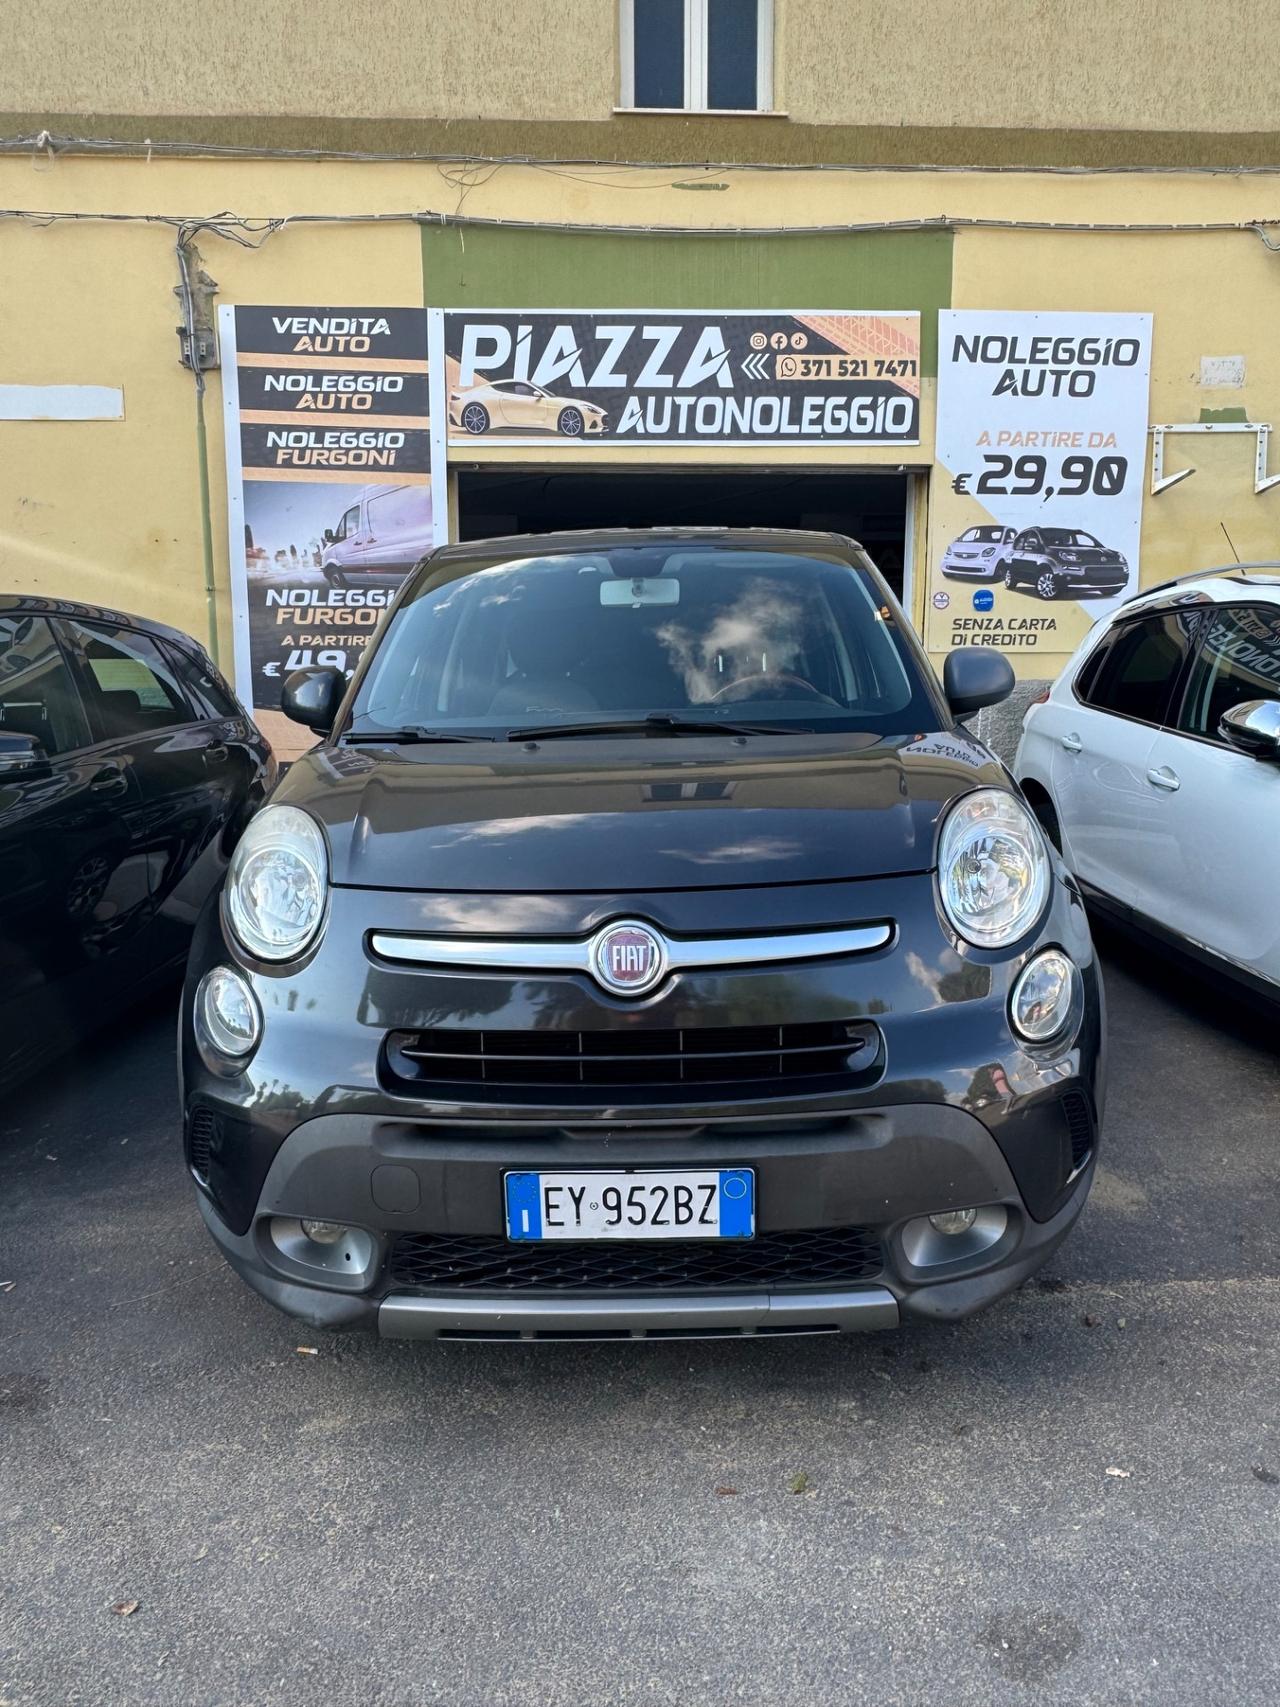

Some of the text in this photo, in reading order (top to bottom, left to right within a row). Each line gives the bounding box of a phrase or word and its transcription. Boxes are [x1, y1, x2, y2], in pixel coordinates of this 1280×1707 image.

[272, 317, 391, 335] VENDITA
[293, 336, 371, 352] AUTO
[952, 335, 1141, 366] NOLEGGIO
[459, 324, 734, 388] PIAZZA
[800, 359, 917, 377] 371 521 7471
[264, 374, 404, 393] NOLEGGIO
[991, 368, 1096, 397] AUTO
[296, 393, 373, 410] AUTO
[616, 395, 914, 434] AUTONOLEGGIO
[266, 431, 405, 448] NOLEGGIO
[976, 430, 1117, 448] A PARTIRE DA
[276, 449, 396, 466] FURGONI
[951, 454, 1128, 502] € 29,90
[266, 589, 396, 606] NOLEGGI
[276, 608, 387, 625] FURGO
[952, 618, 1057, 631] SENZA CARTA
[281, 635, 294, 646] A
[951, 634, 1038, 646] DI CREDITO
[262, 662, 281, 677] €
[612, 945, 647, 971] FIAT
[543, 1186, 587, 1227] EY
[601, 1184, 718, 1226] 952BZ
